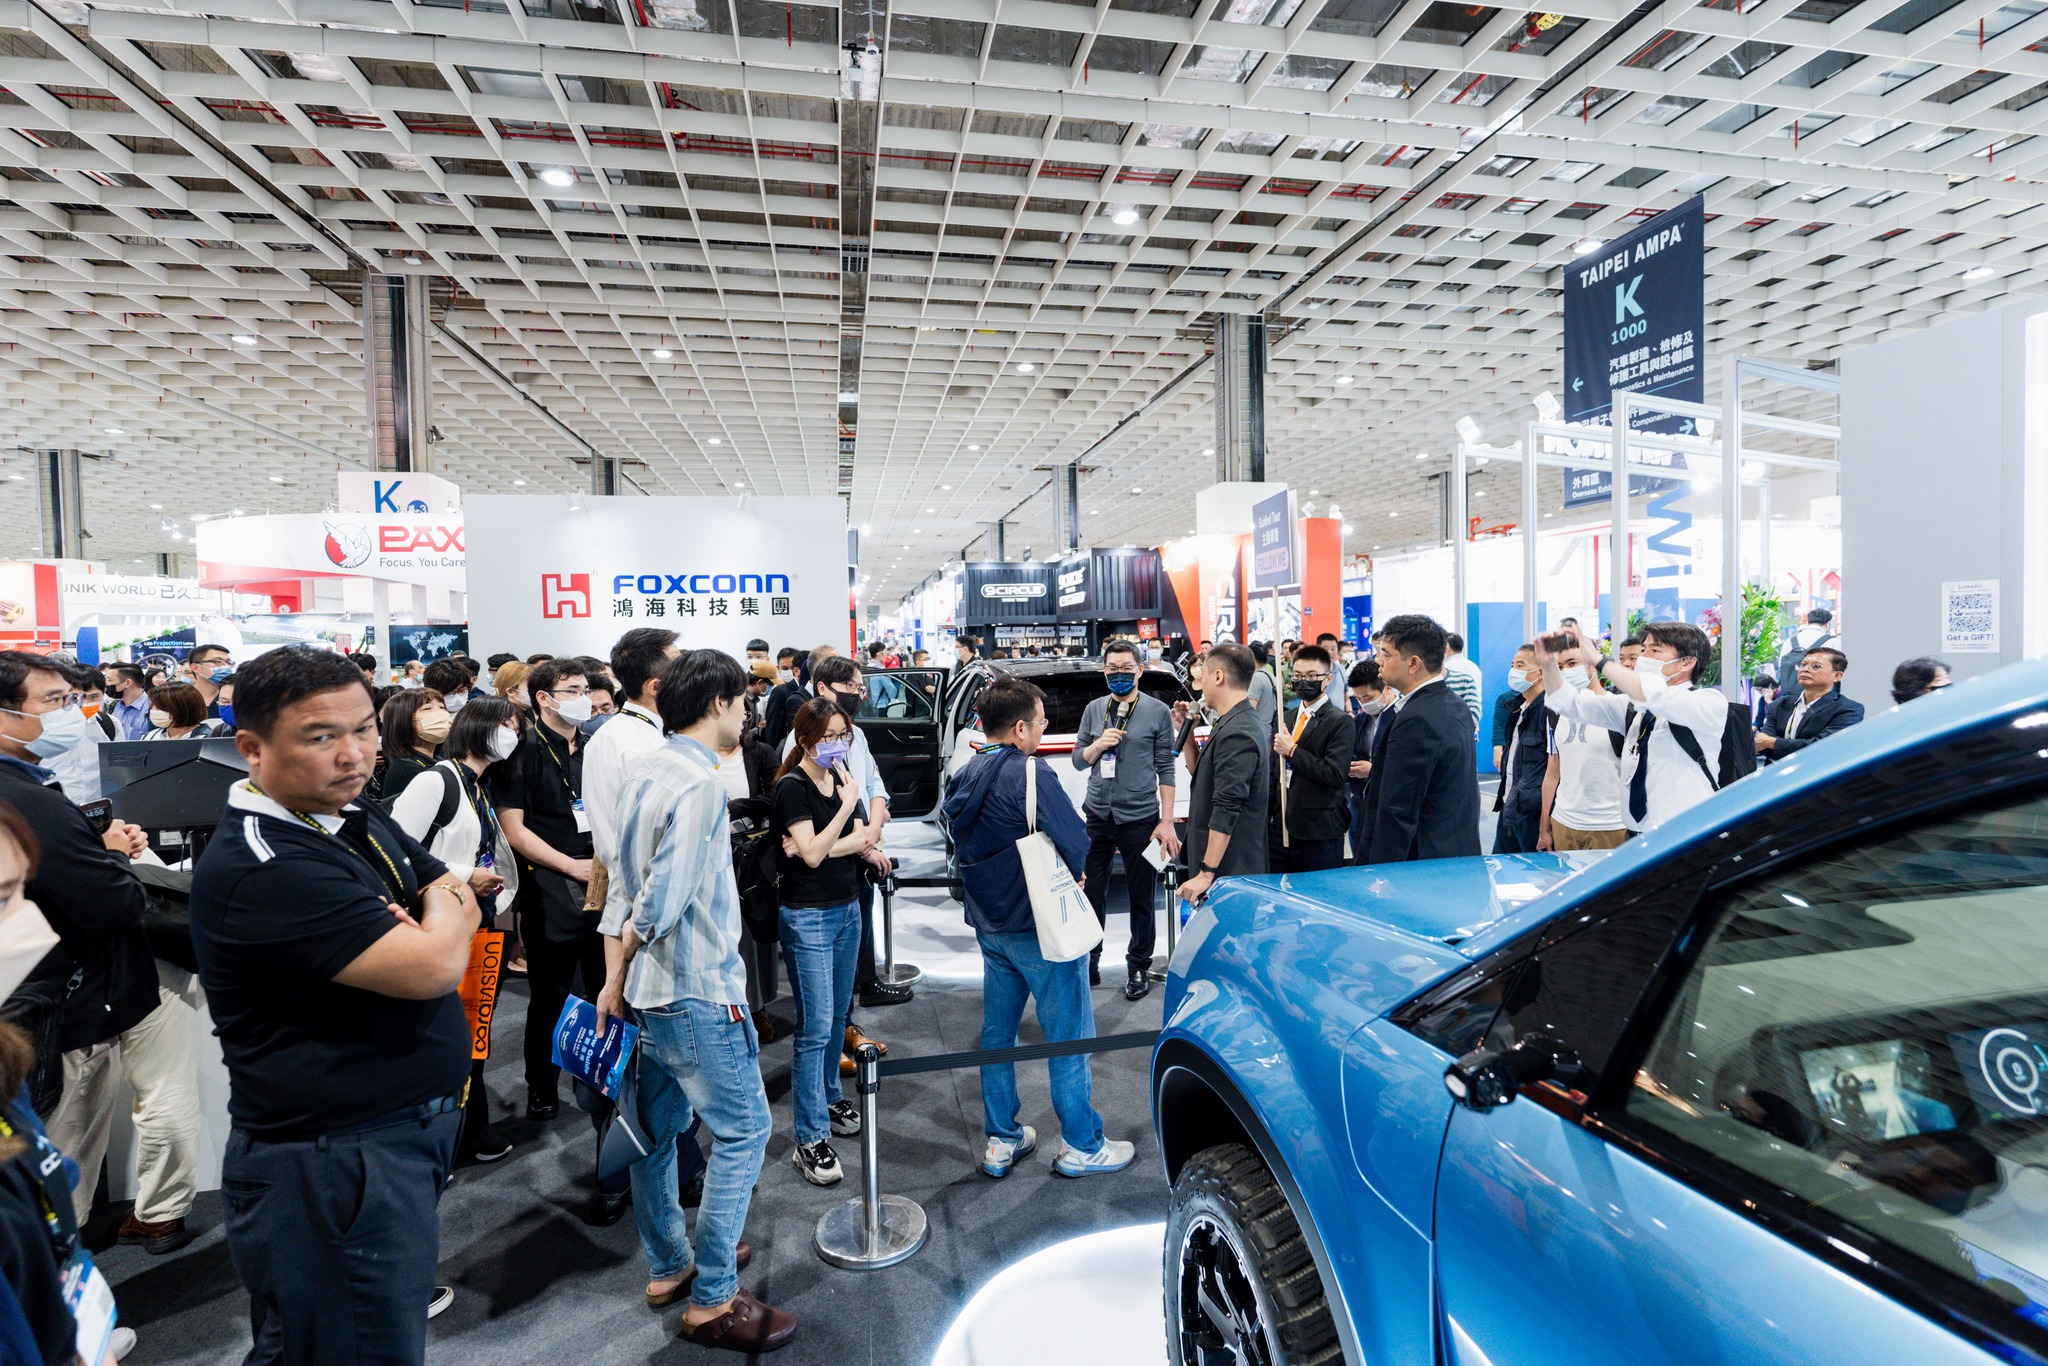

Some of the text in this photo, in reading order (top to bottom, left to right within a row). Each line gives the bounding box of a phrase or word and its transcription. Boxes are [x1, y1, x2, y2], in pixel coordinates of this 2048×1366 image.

[1580, 225, 1682, 289] TAIPEI AMPA
[1616, 274, 1645, 325] K
[1611, 319, 1647, 345] 1000
[1647, 377, 1652, 386] &
[1653, 365, 1694, 383] Maintenance
[1572, 471, 1600, 489] 外商區
[374, 480, 403, 513] K
[1572, 488, 1597, 499] Overseas
[418, 557, 438, 567] You
[441, 557, 466, 567] Care
[103, 585, 156, 596] WORLD
[613, 574, 790, 594] FOXCONN
[985, 586, 1042, 596] 9CIRCLE
[613, 597, 790, 618] 鴻海科技集團
[584, 1049, 593, 1075] Guide
